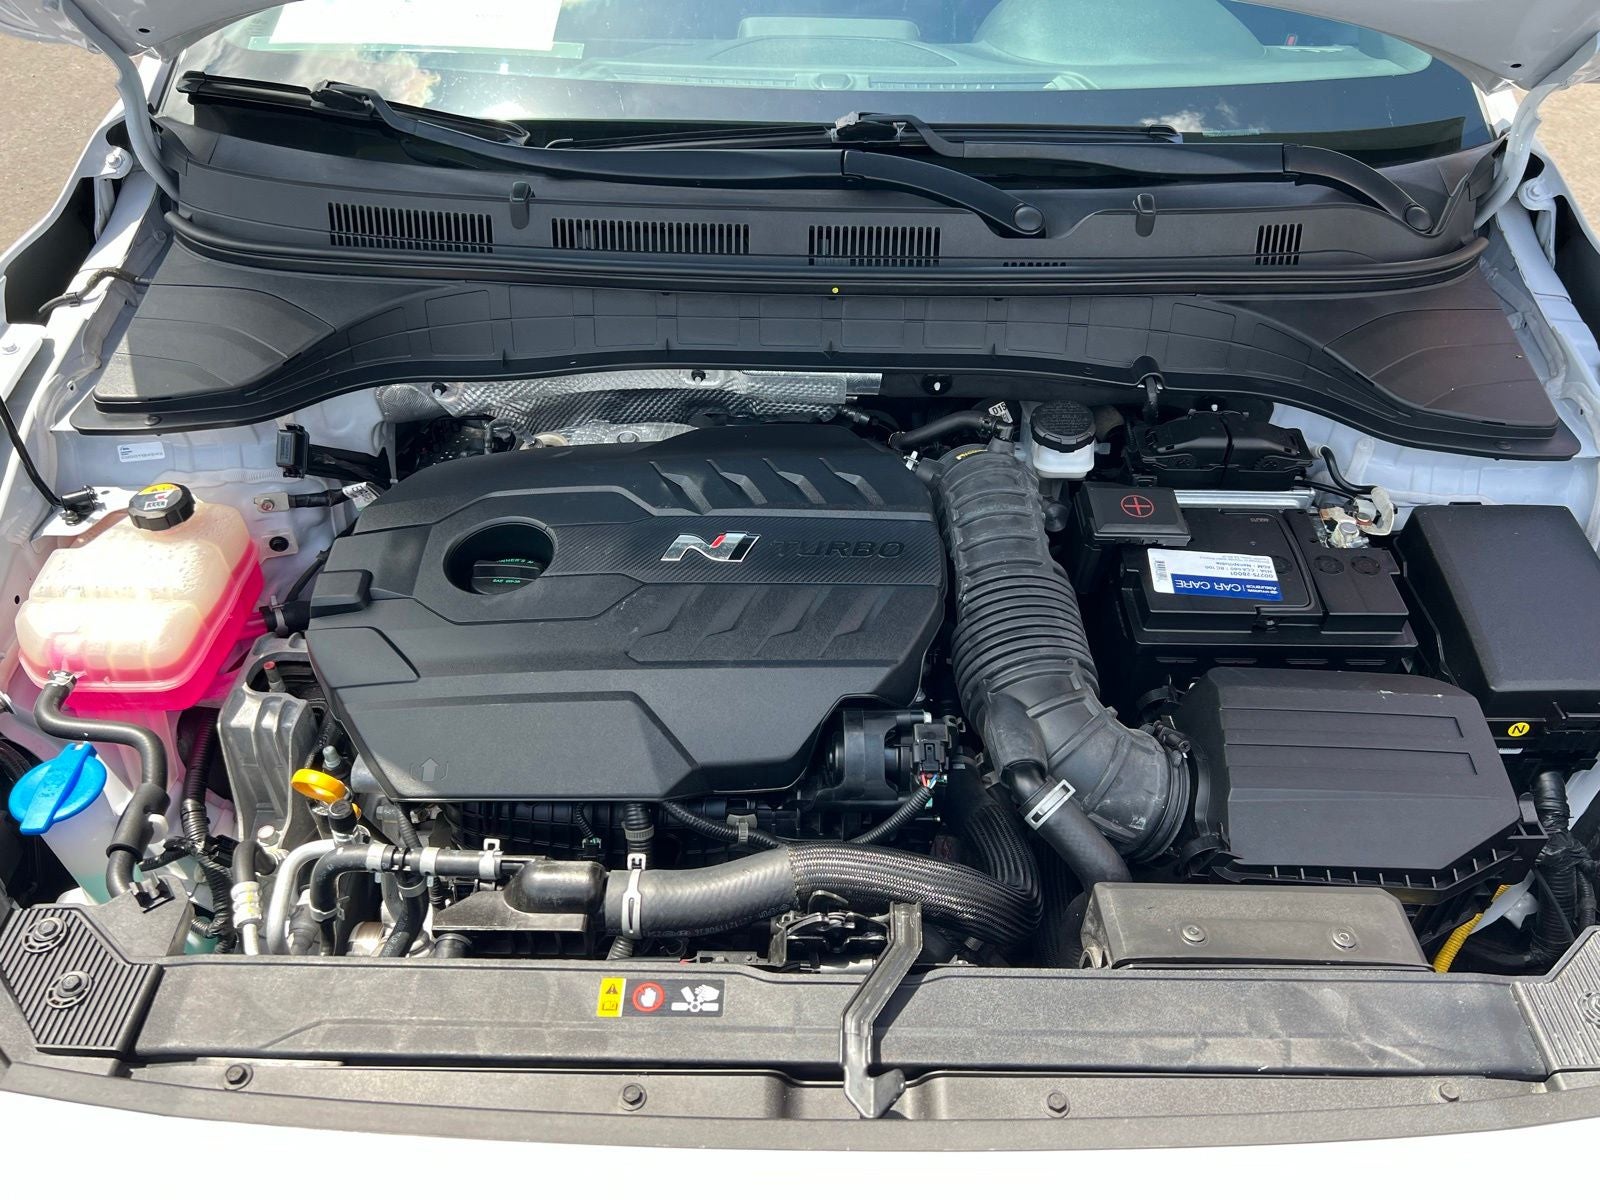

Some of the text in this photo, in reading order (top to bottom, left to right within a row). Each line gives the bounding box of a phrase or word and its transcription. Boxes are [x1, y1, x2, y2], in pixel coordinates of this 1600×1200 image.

[770, 539, 905, 559] TURBO
[1174, 579, 1211, 590] CARE
[1214, 582, 1241, 592] CAR
